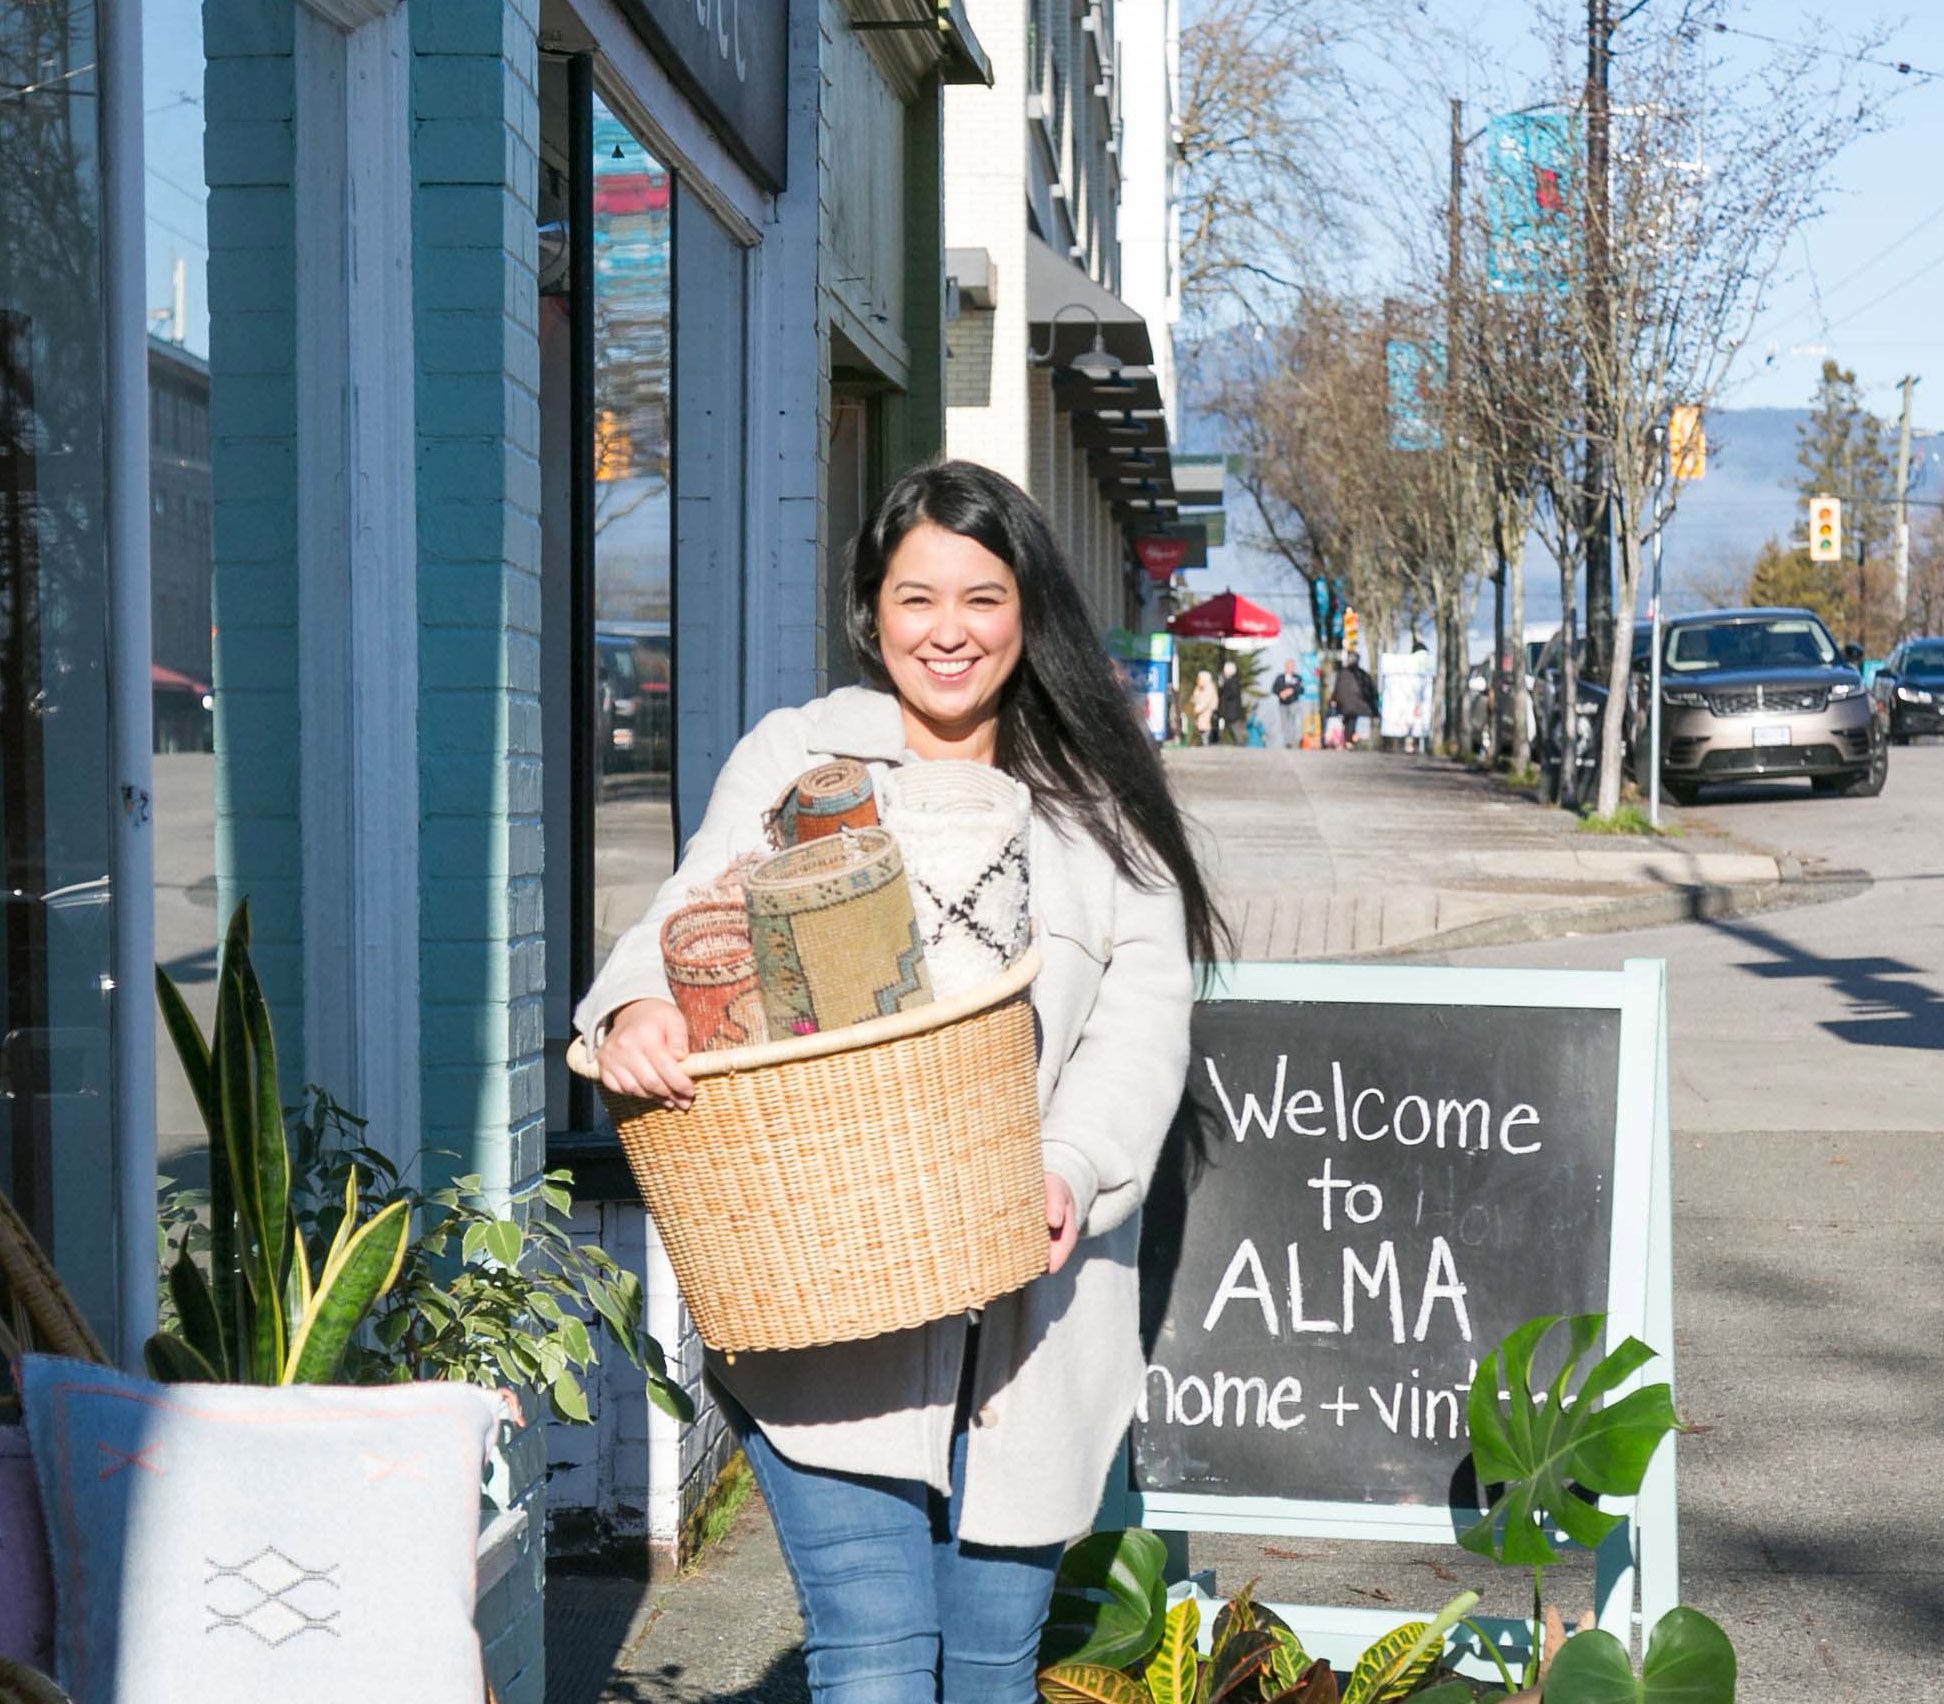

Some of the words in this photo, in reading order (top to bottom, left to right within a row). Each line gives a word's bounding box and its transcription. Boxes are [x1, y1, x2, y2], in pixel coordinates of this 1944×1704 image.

[1206, 1055, 1541, 1154] Welcome
[1308, 1158, 1382, 1230] to
[1203, 1236, 1472, 1343] ALMA
[1320, 1386, 1359, 1426] +
